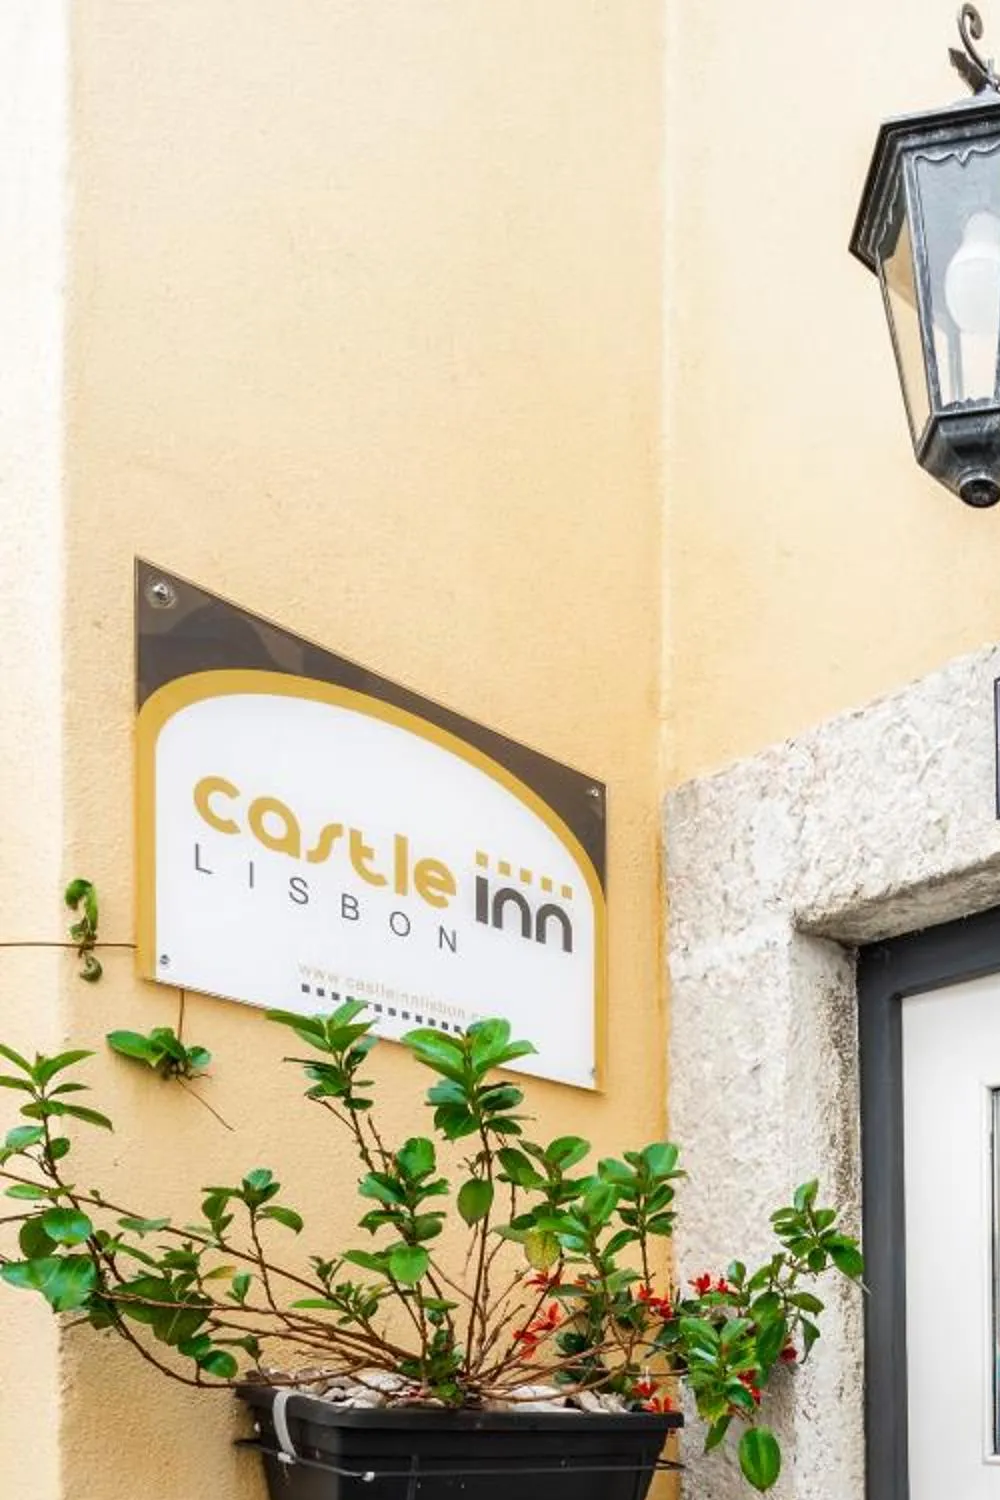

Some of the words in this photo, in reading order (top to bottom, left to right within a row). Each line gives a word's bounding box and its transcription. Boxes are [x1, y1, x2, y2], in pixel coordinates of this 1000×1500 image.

[193, 776, 457, 909] castle
[475, 850, 573, 953] inn
[195, 843, 458, 953] LISBON
